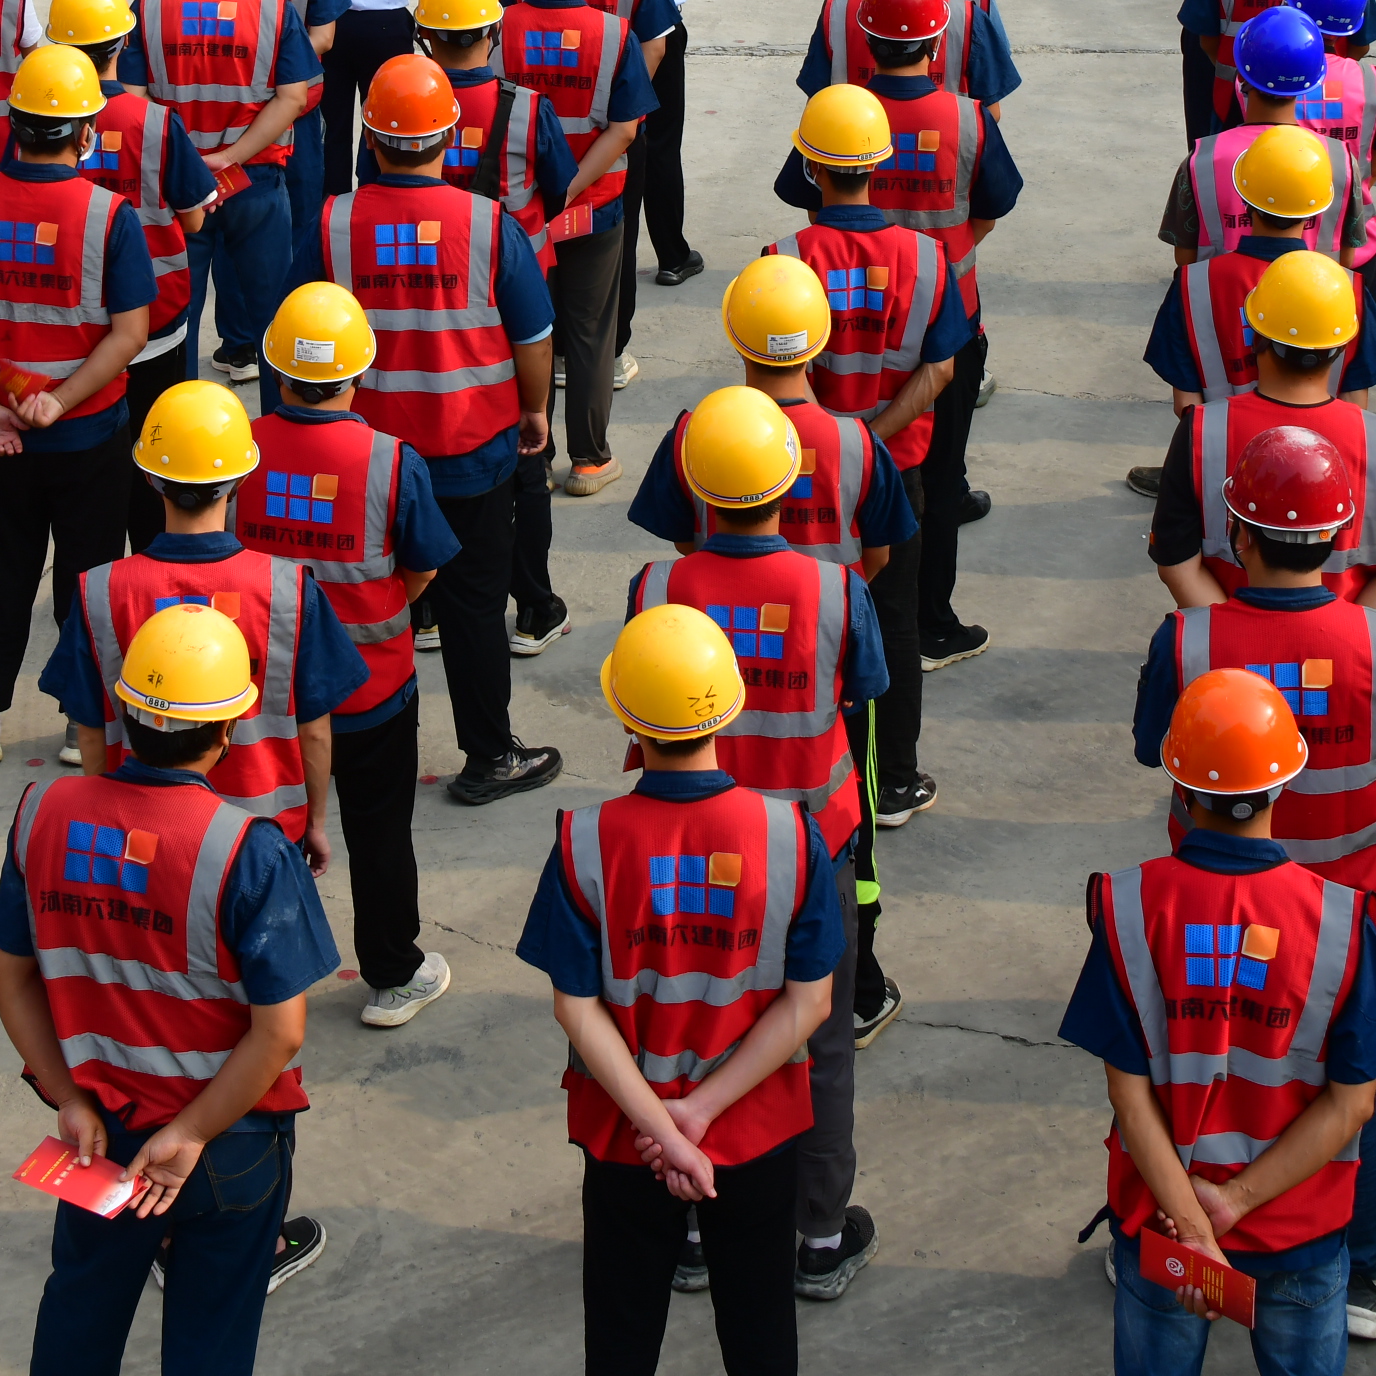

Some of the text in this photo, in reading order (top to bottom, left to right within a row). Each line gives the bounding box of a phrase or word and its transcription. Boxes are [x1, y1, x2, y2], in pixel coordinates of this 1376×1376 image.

[165, 42, 250, 60] 河南六建集团
[869, 175, 956, 195] 南六建集团
[355, 273, 458, 291] 河南六建集团
[242, 521, 356, 552] 河南六建集团
[38, 889, 174, 936] 河南六建集团
[625, 925, 760, 952] 河南六建集团
